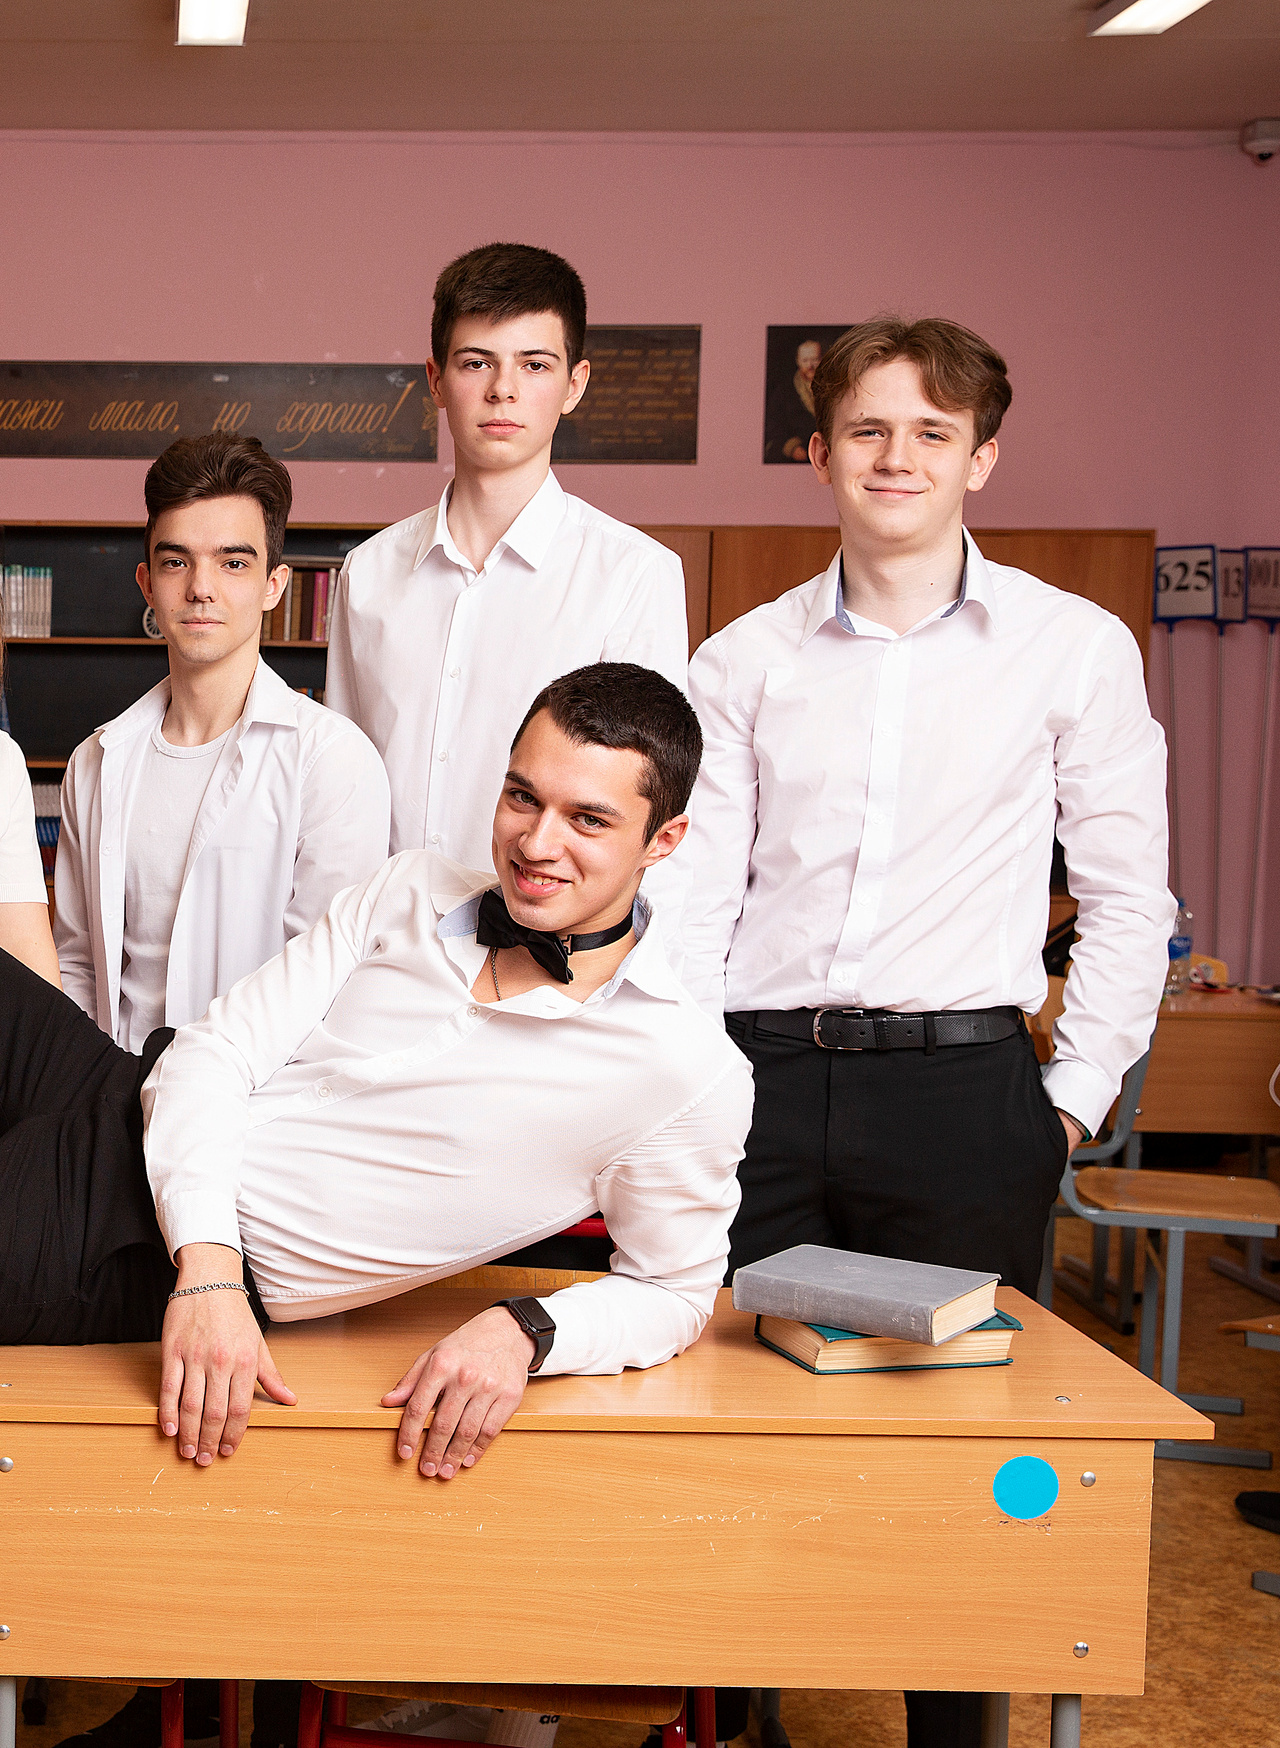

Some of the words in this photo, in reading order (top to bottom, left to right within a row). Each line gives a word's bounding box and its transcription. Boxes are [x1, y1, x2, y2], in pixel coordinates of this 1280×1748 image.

[88, 399, 180, 434] мало,
[211, 401, 252, 433] но
[275, 379, 417, 453] хорошо!
